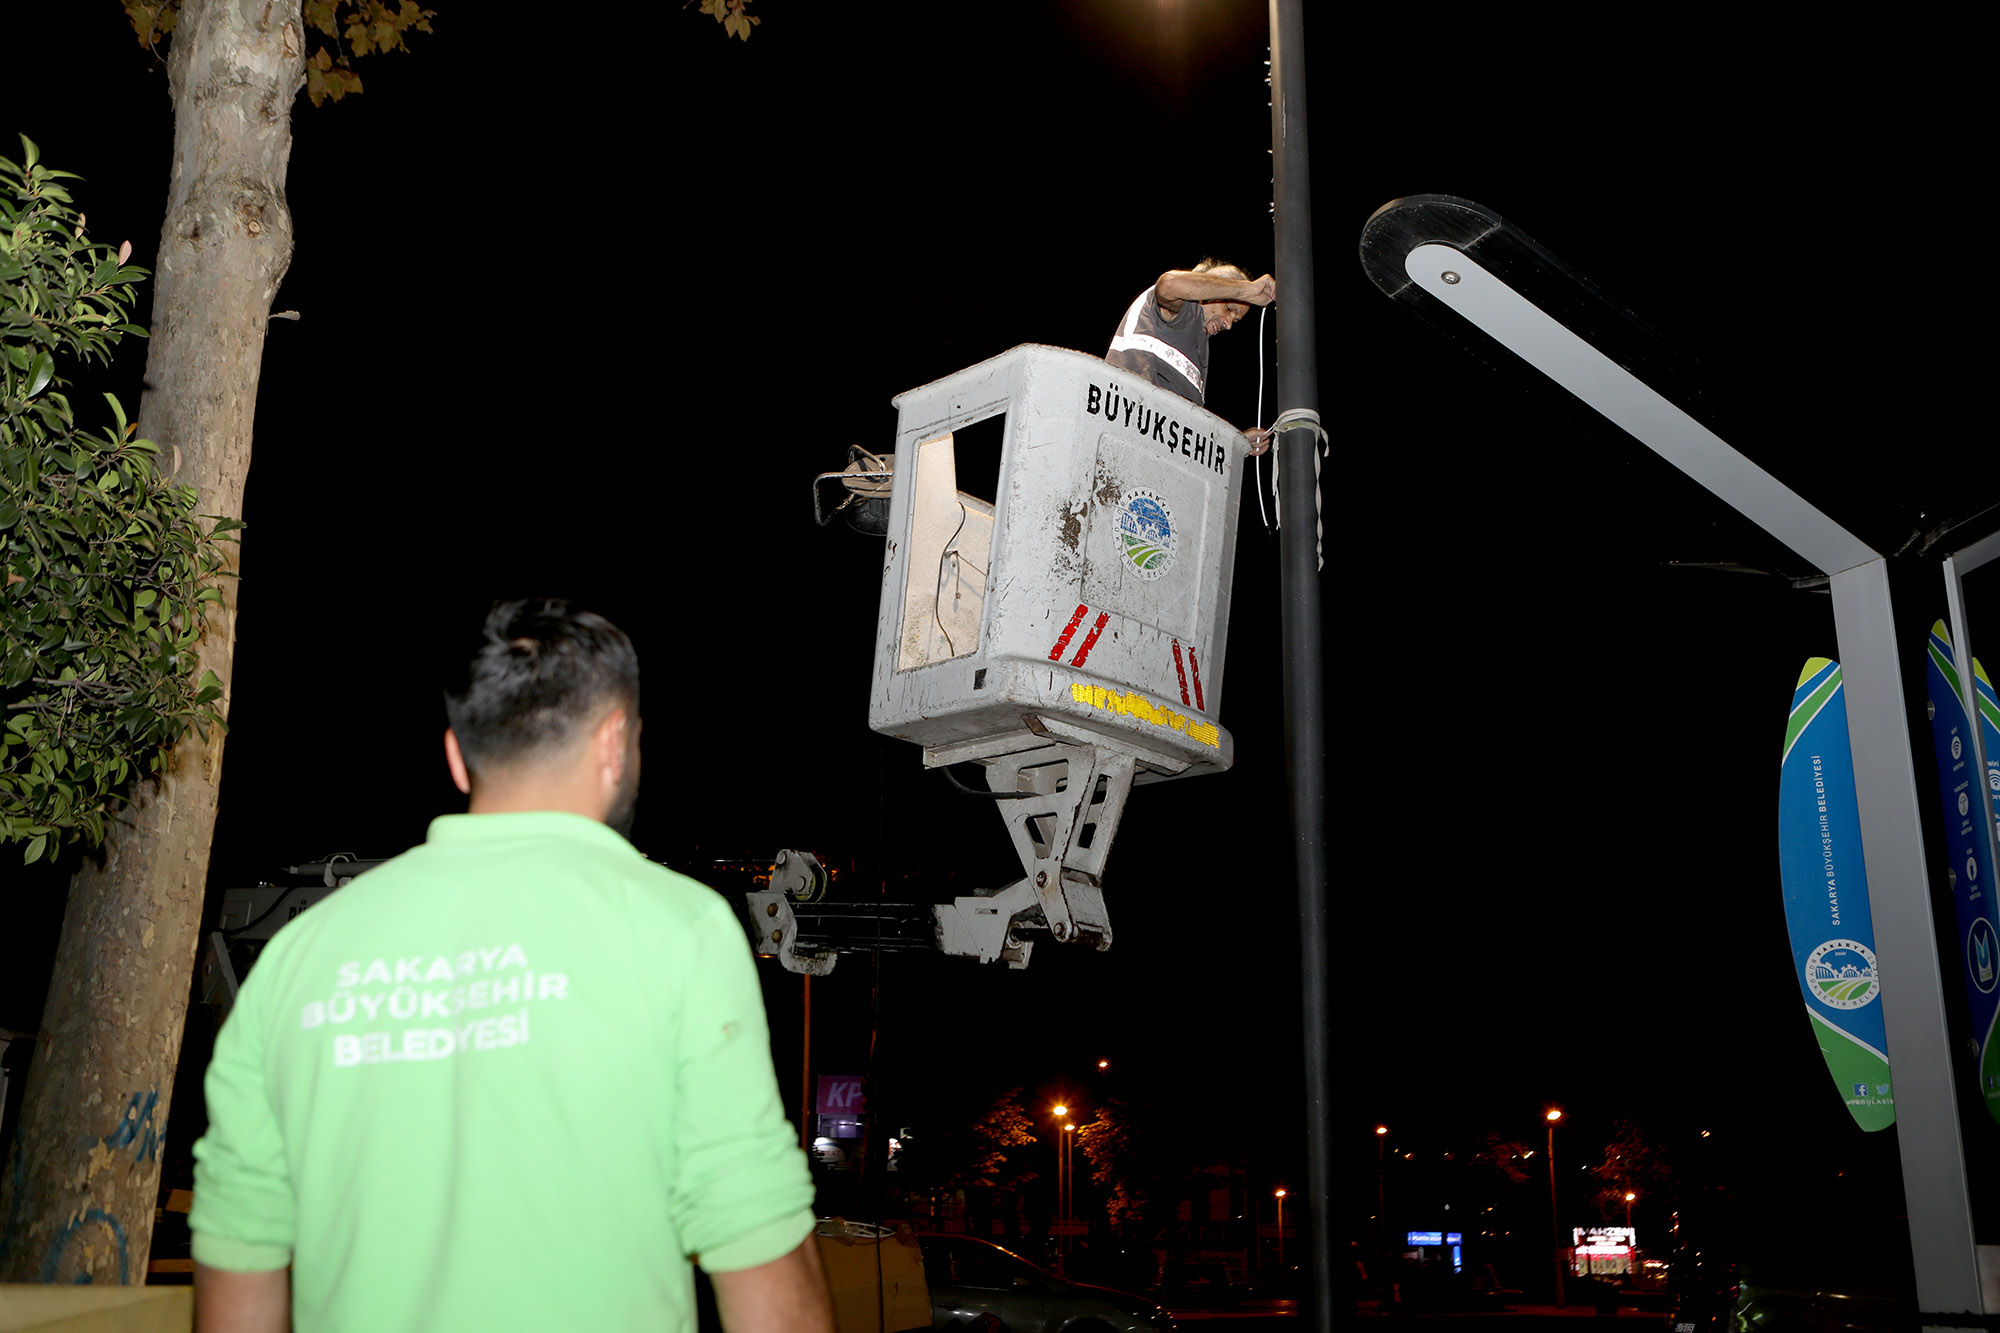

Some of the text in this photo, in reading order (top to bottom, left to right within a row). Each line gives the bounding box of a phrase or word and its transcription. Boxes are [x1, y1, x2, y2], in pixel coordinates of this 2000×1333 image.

[1810, 755, 1840, 926] SAKARYA BÜYÜKŞEHİR BELEDİYESİ
[336, 944, 528, 988] SAKARYA
[1816, 942, 1866, 956] SAKARYA
